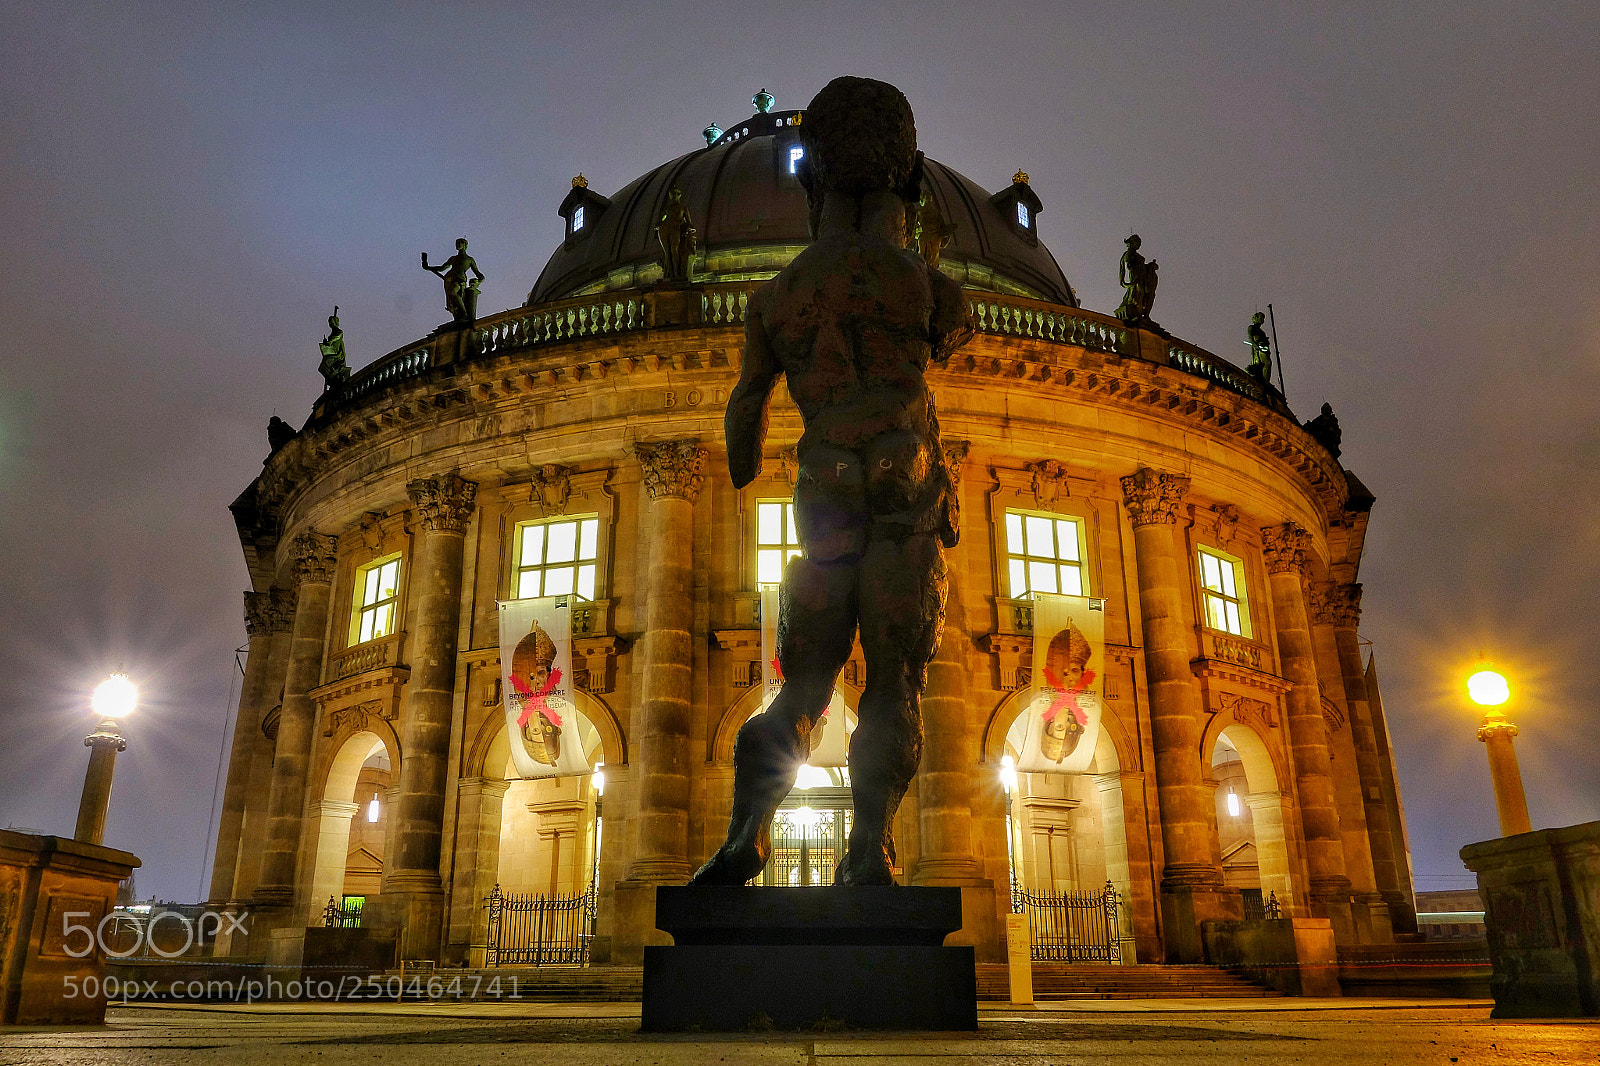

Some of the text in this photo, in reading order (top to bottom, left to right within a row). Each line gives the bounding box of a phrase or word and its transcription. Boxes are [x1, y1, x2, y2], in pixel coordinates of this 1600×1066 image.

[663, 388, 729, 408] BOD
[509, 689, 565, 700] BEYOND COMPARE
